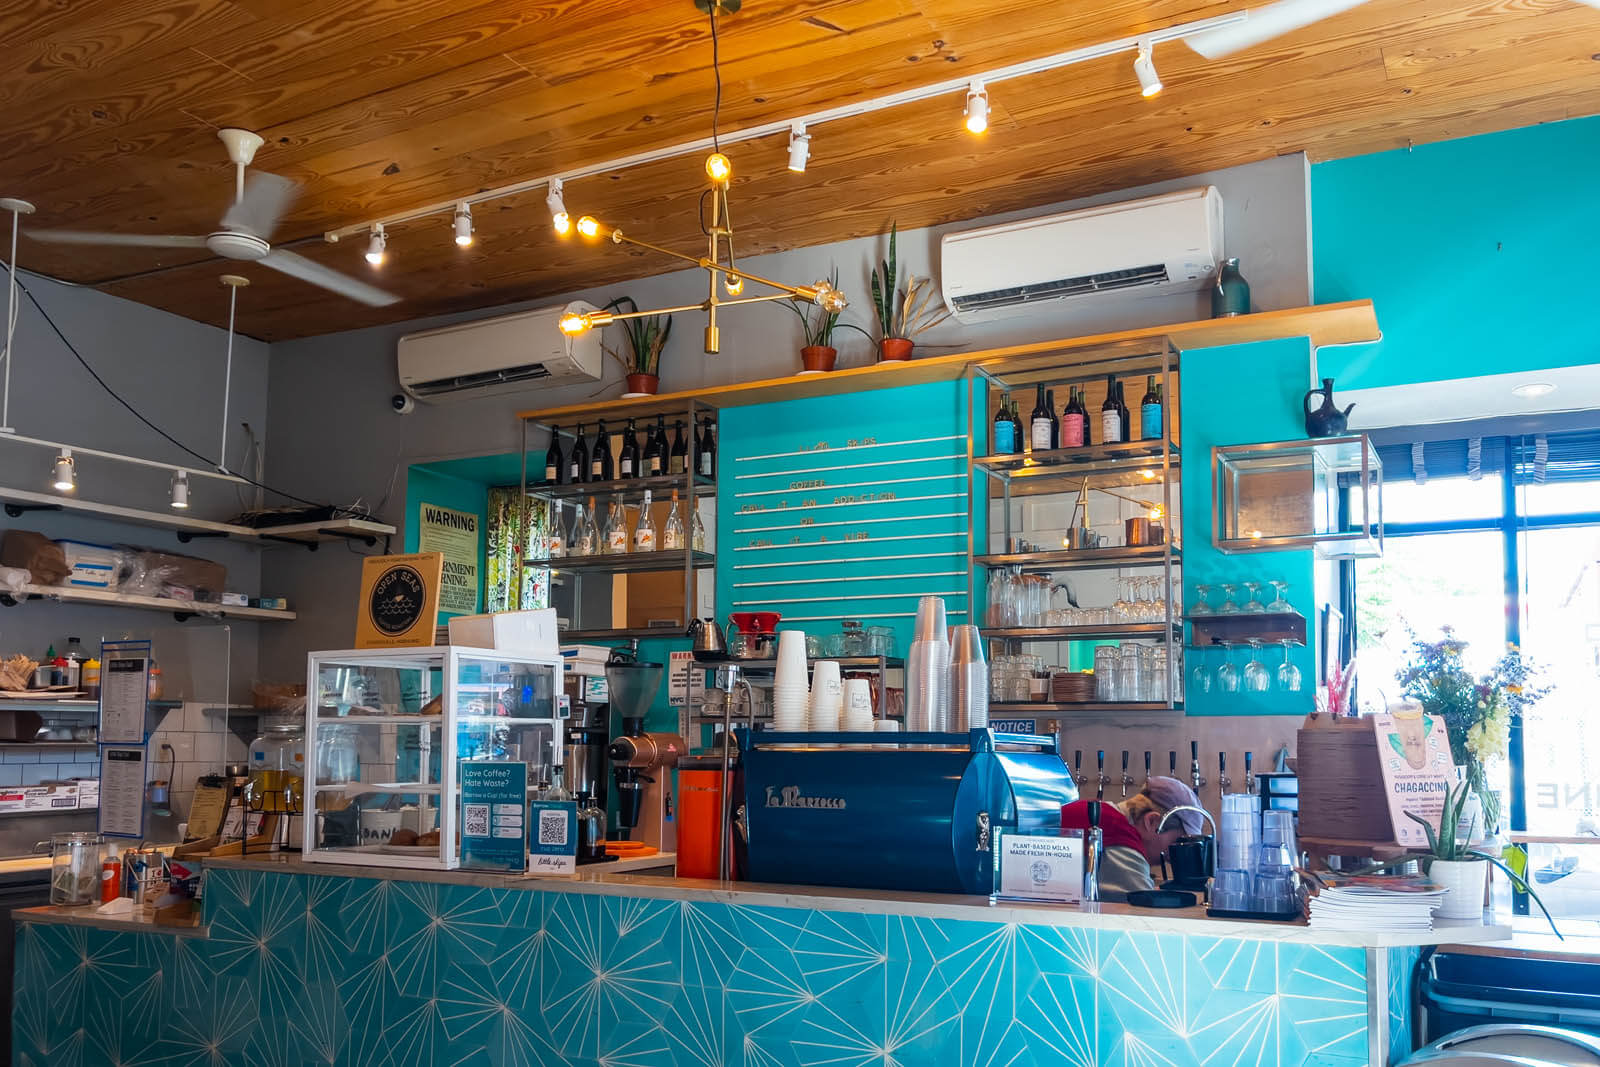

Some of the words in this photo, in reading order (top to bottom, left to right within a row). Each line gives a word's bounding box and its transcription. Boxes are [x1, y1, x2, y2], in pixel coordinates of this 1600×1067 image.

[790, 480, 825, 490] COFFEE
[802, 498, 817, 507] AN
[425, 507, 475, 532] WARNING
[442, 560, 475, 577] RNMENT
[377, 572, 397, 595] OPEN
[400, 571, 420, 593] SEAS
[991, 722, 1033, 733] NOTICE
[465, 769, 482, 778] Love
[483, 769, 511, 778] Coffee?
[464, 779, 481, 787] Hate
[483, 780, 510, 788] Waste?
[780, 785, 847, 810] Marzocco
[1012, 842, 1051, 851] PLANT-BASED
[1045, 851, 1073, 859] IN-HOUSE
